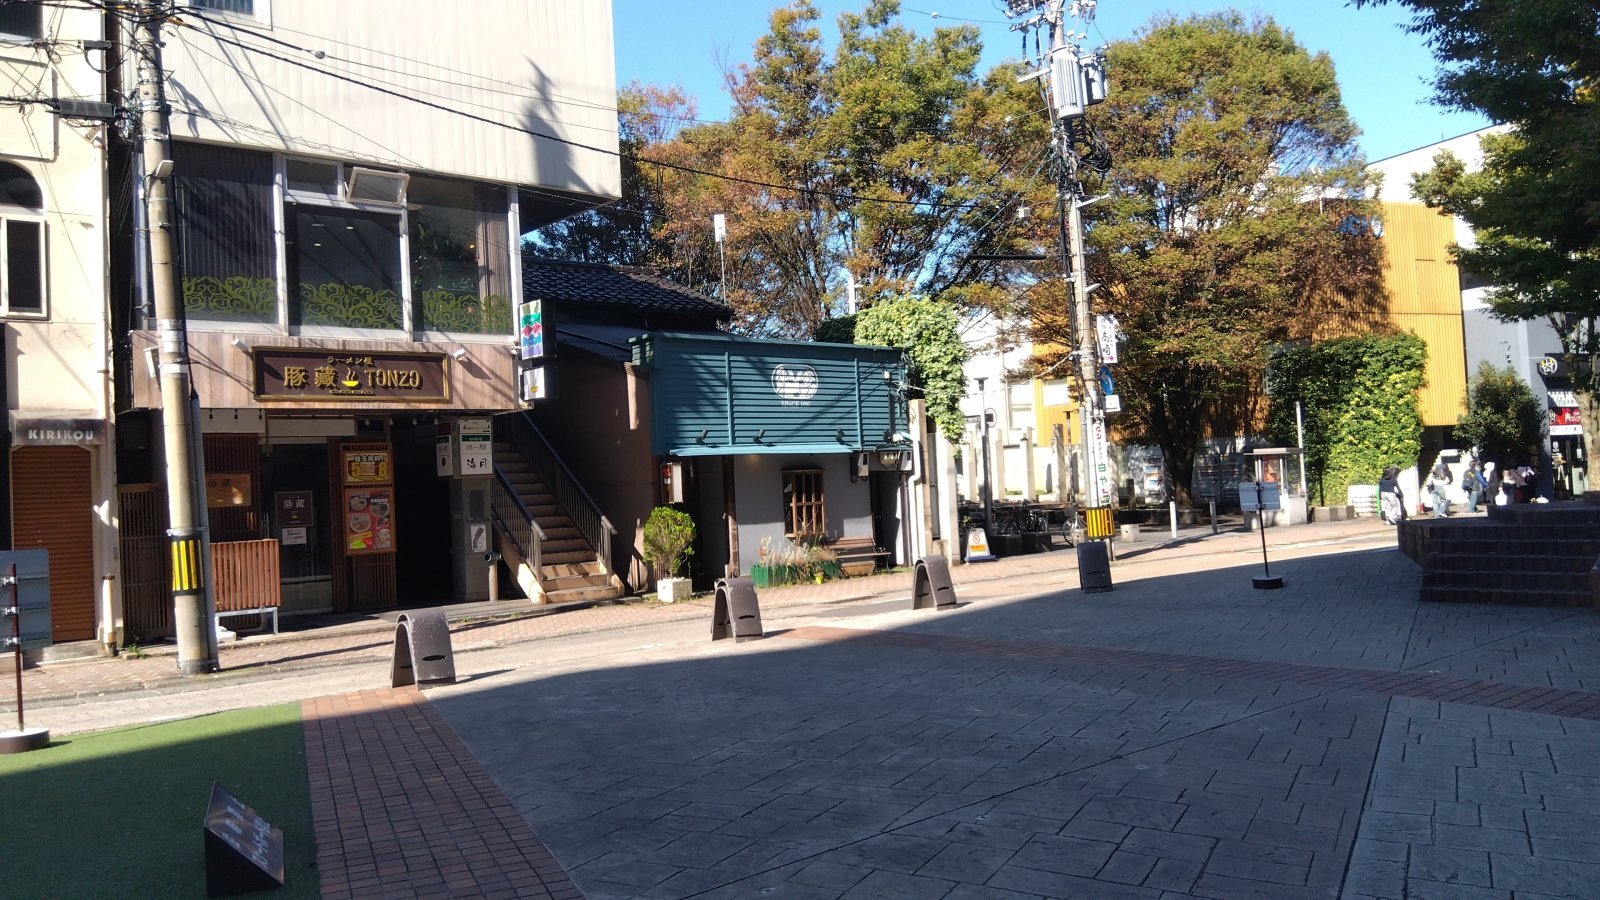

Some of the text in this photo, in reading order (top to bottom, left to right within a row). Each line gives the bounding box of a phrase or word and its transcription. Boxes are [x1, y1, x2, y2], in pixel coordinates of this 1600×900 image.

[327, 355, 374, 366] ラーメン屋
[364, 369, 420, 388] TONZO
[28, 429, 94, 440] KIRIKOU
